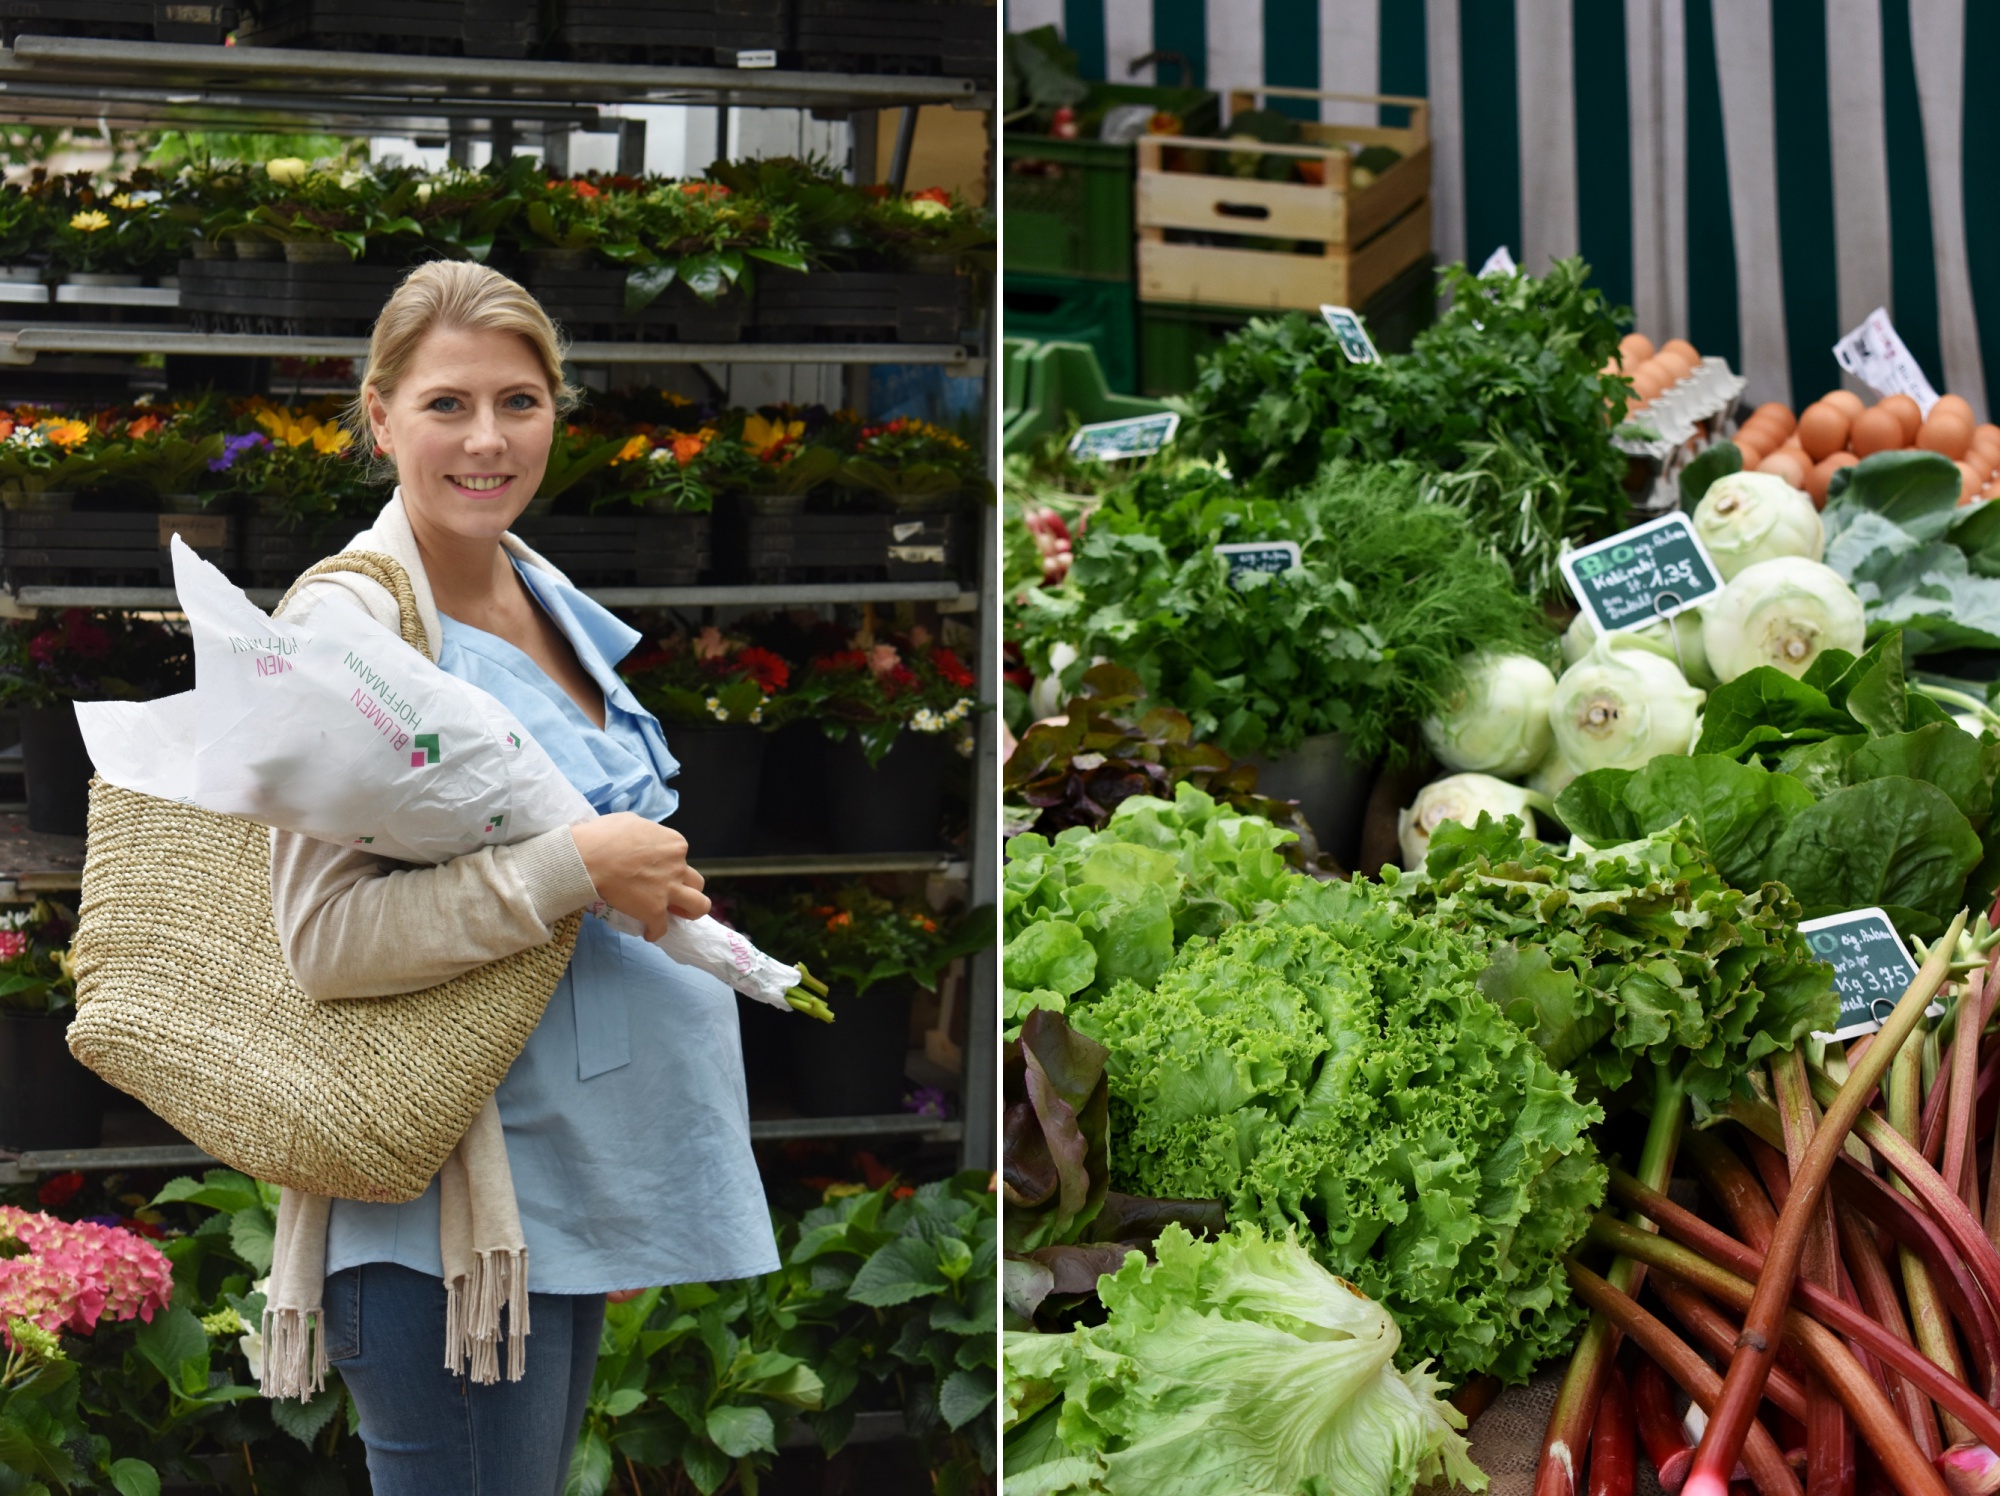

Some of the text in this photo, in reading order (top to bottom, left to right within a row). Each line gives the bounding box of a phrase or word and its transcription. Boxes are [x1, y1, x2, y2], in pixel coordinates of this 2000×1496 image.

[1577, 545, 1635, 579] BIO
[1650, 558, 1692, 588] 1,35
[256, 655, 293, 678] MEN
[344, 651, 422, 731] HOFFMANN
[350, 687, 409, 751] BLUMEN
[1862, 965, 1909, 993] 3,75
